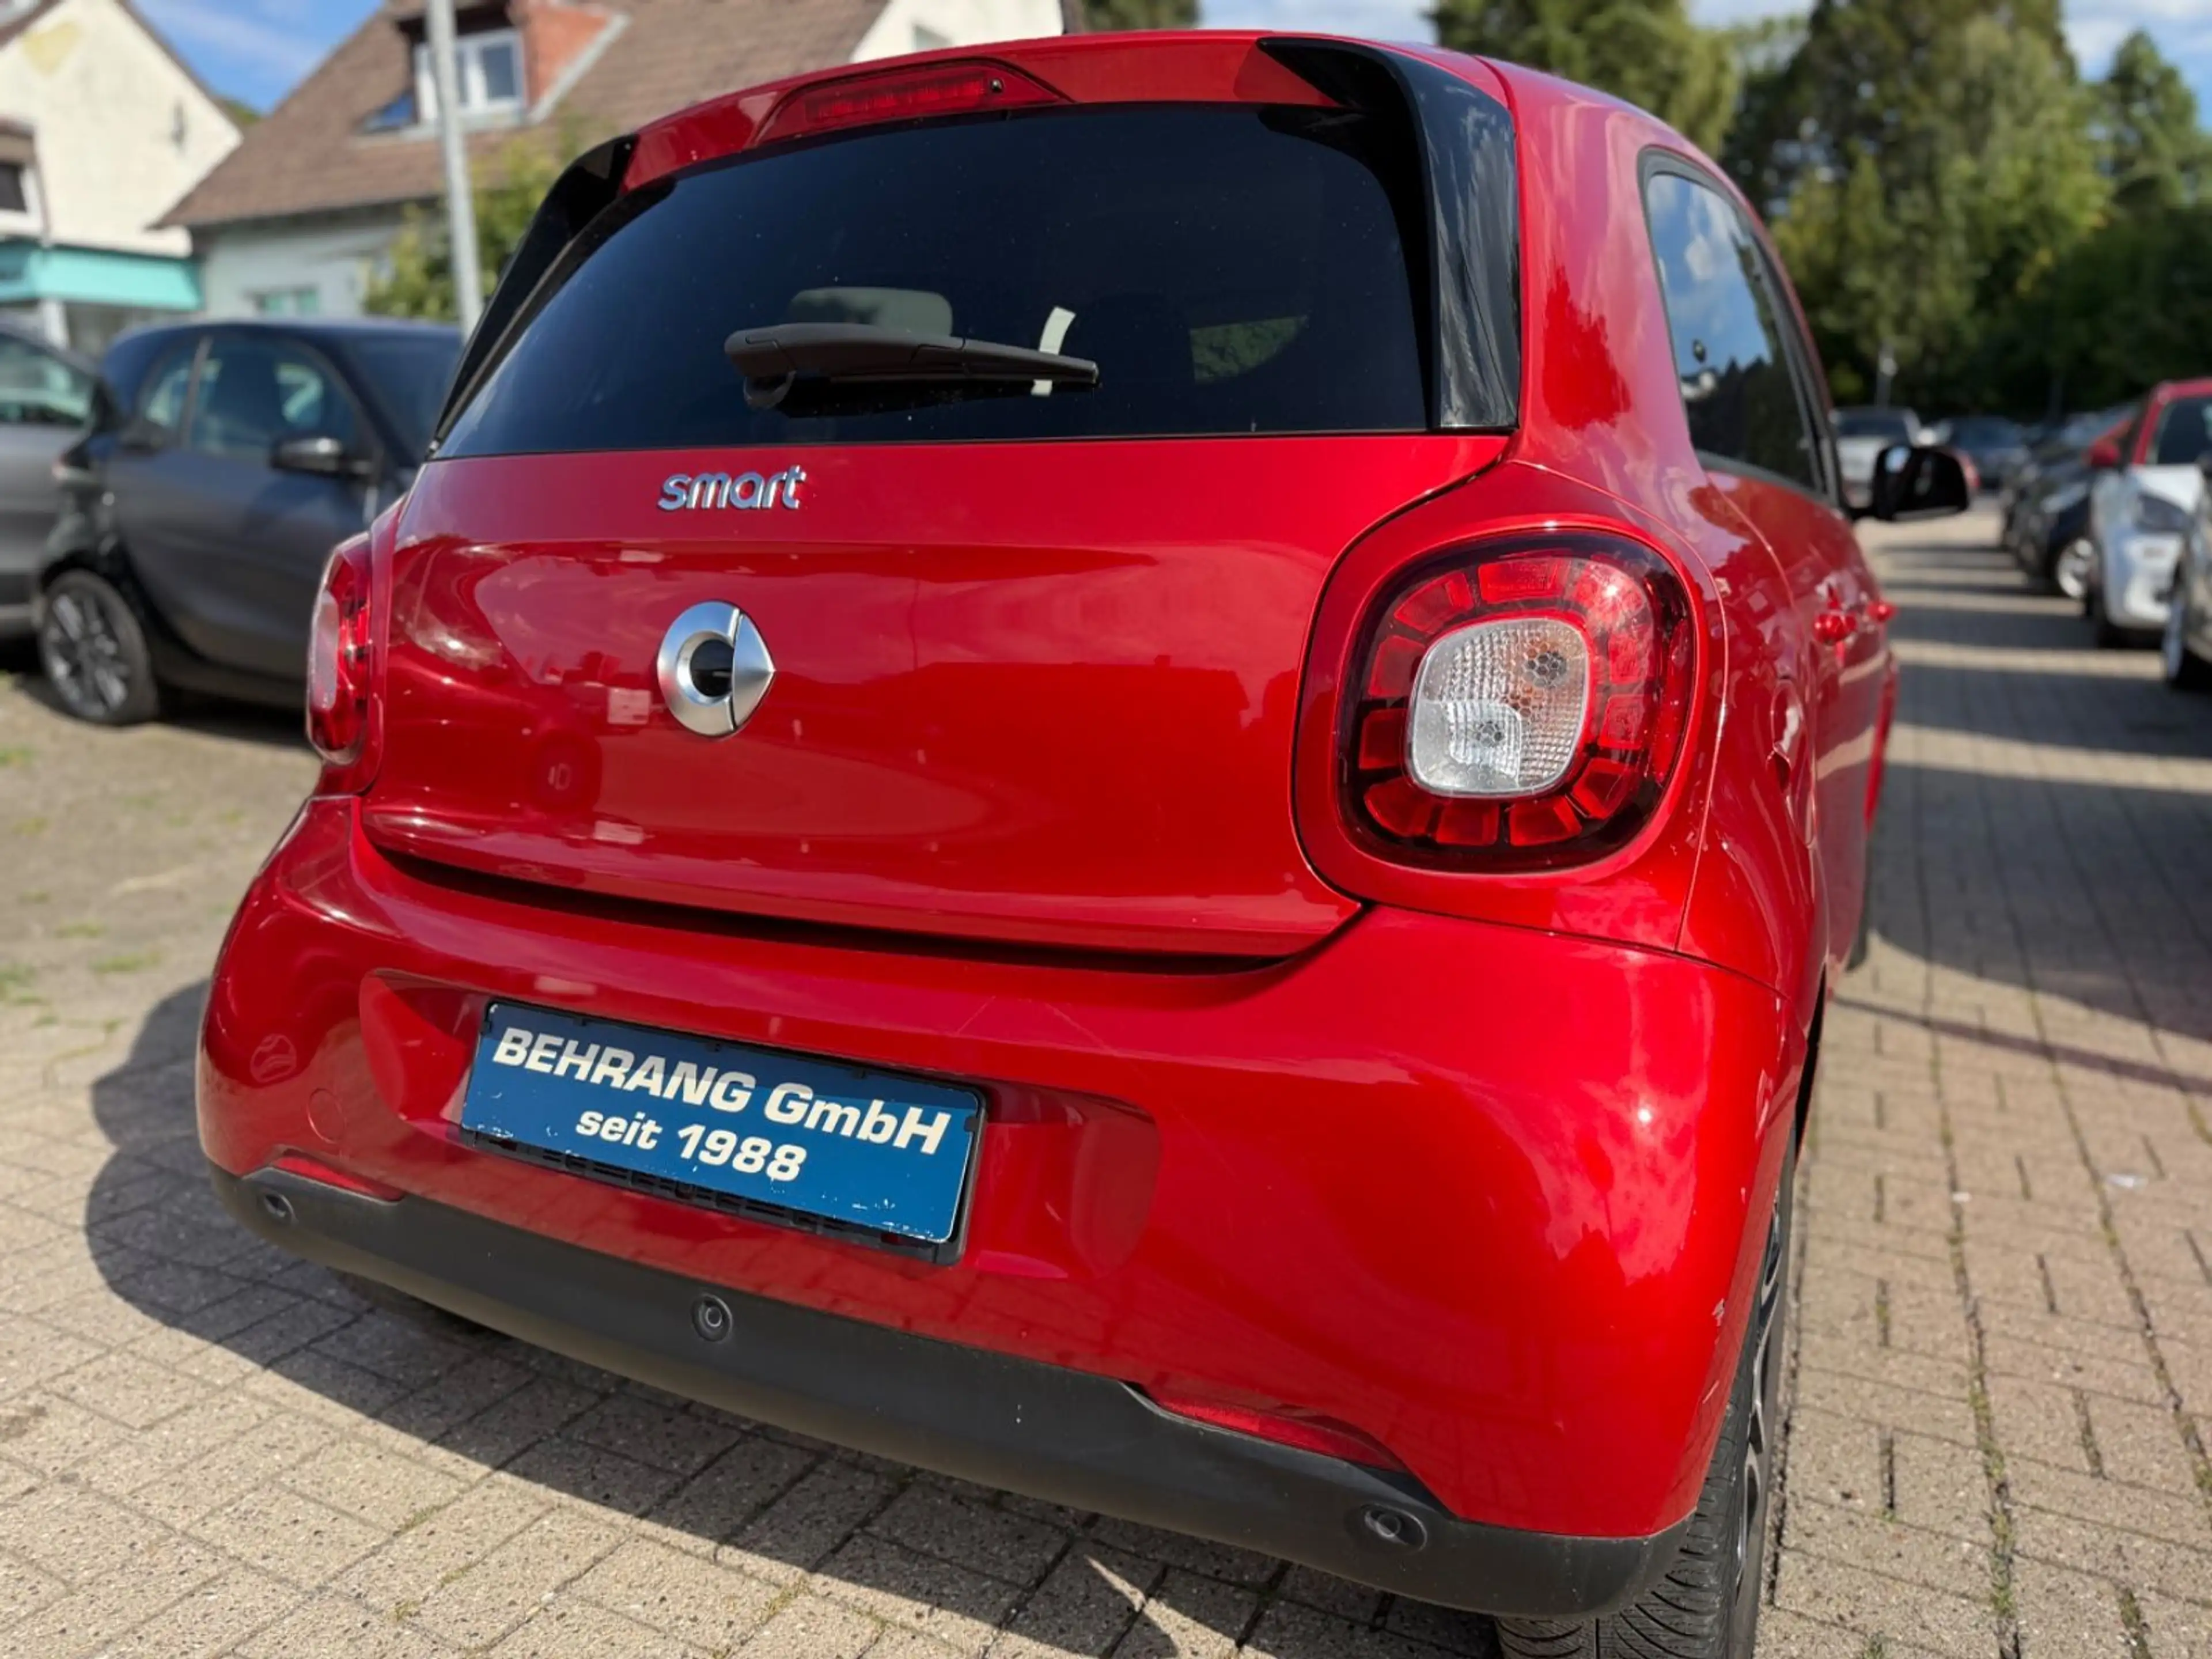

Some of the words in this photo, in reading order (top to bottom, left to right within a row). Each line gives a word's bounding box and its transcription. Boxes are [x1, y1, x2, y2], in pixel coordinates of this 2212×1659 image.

[657, 464, 806, 510] smart
[493, 1027, 758, 1113] BEHRANG
[764, 1082, 952, 1154] GmbH
[575, 1110, 664, 1150] seit
[677, 1124, 806, 1182] 1988
